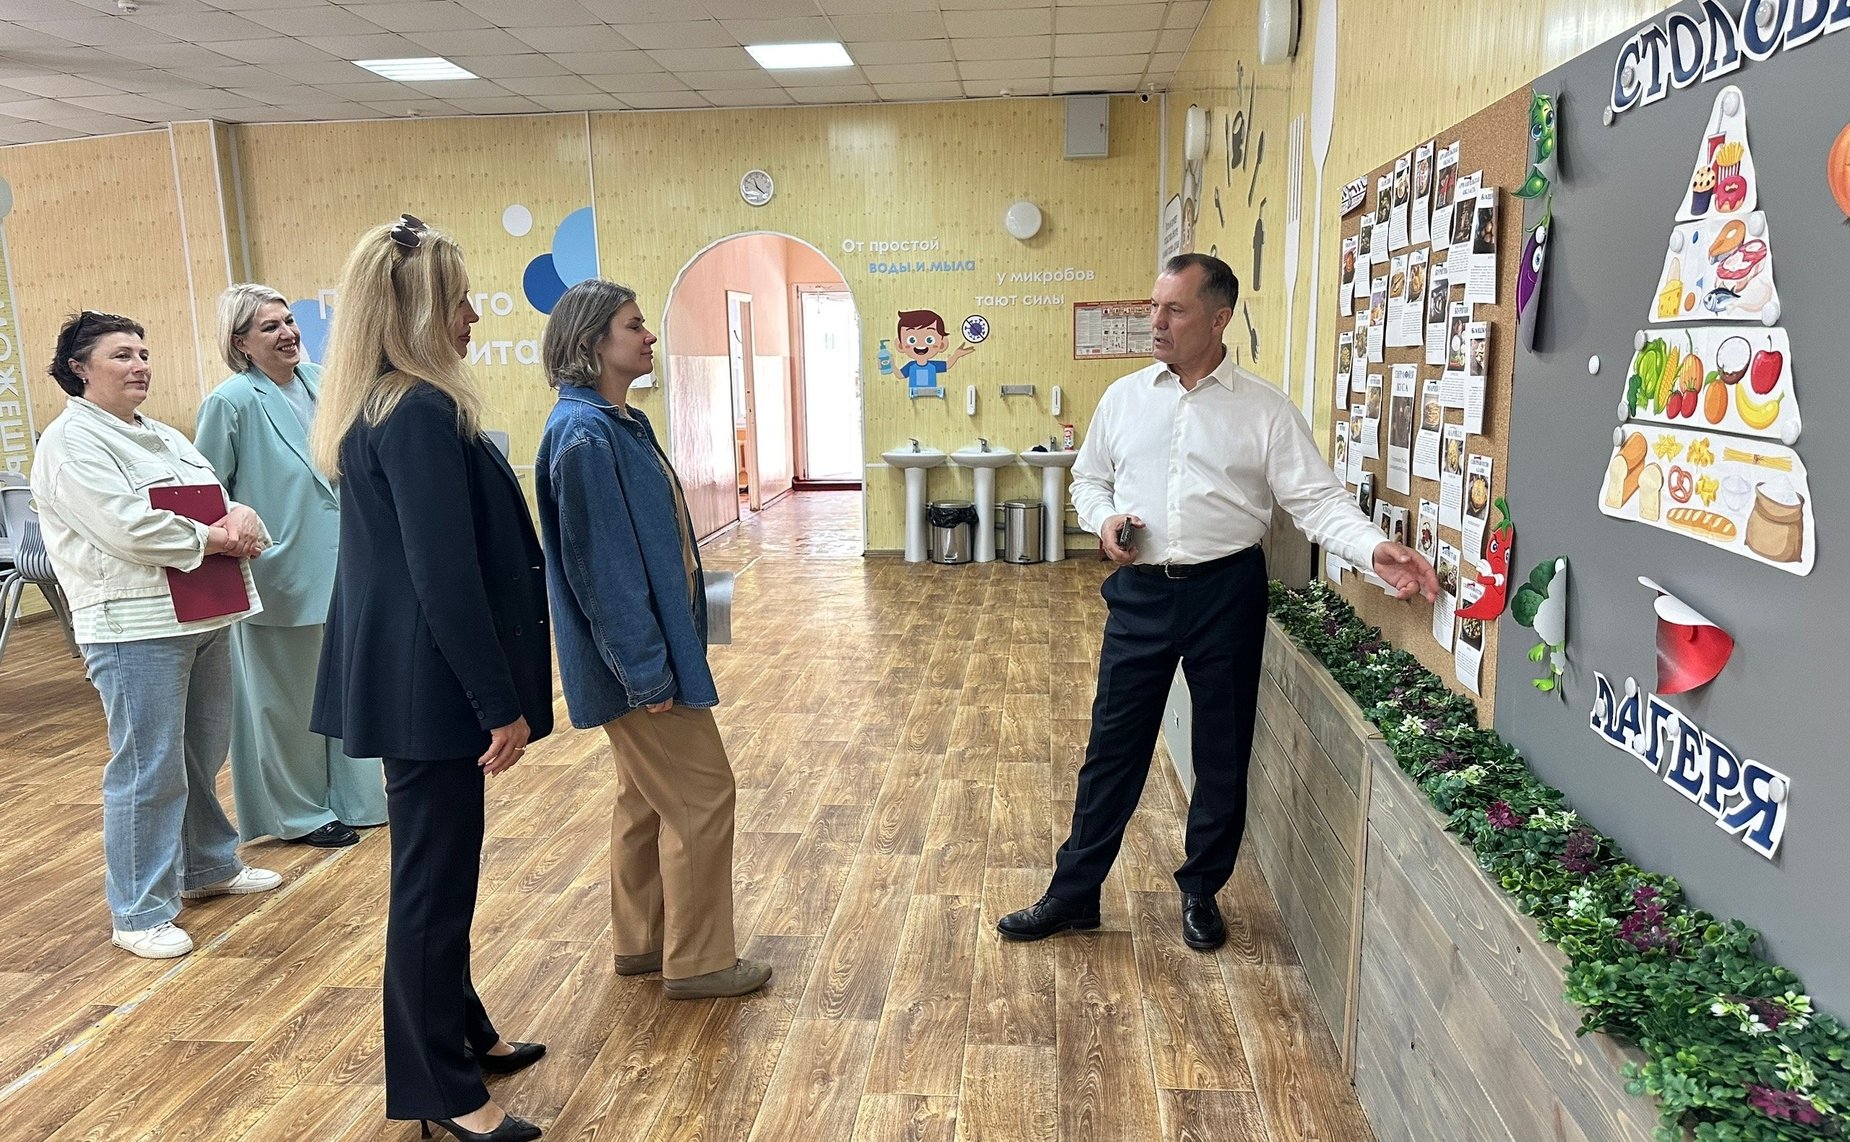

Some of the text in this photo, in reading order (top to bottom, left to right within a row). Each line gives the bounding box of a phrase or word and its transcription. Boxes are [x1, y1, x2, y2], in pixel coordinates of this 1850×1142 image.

[842, 236, 940, 254] От простой
[869, 260, 976, 274] воды и мыла
[997, 267, 1095, 286] у микробов
[975, 294, 1065, 306] тают силы
[1591, 675, 1775, 852] ЛАГЕРЯ
